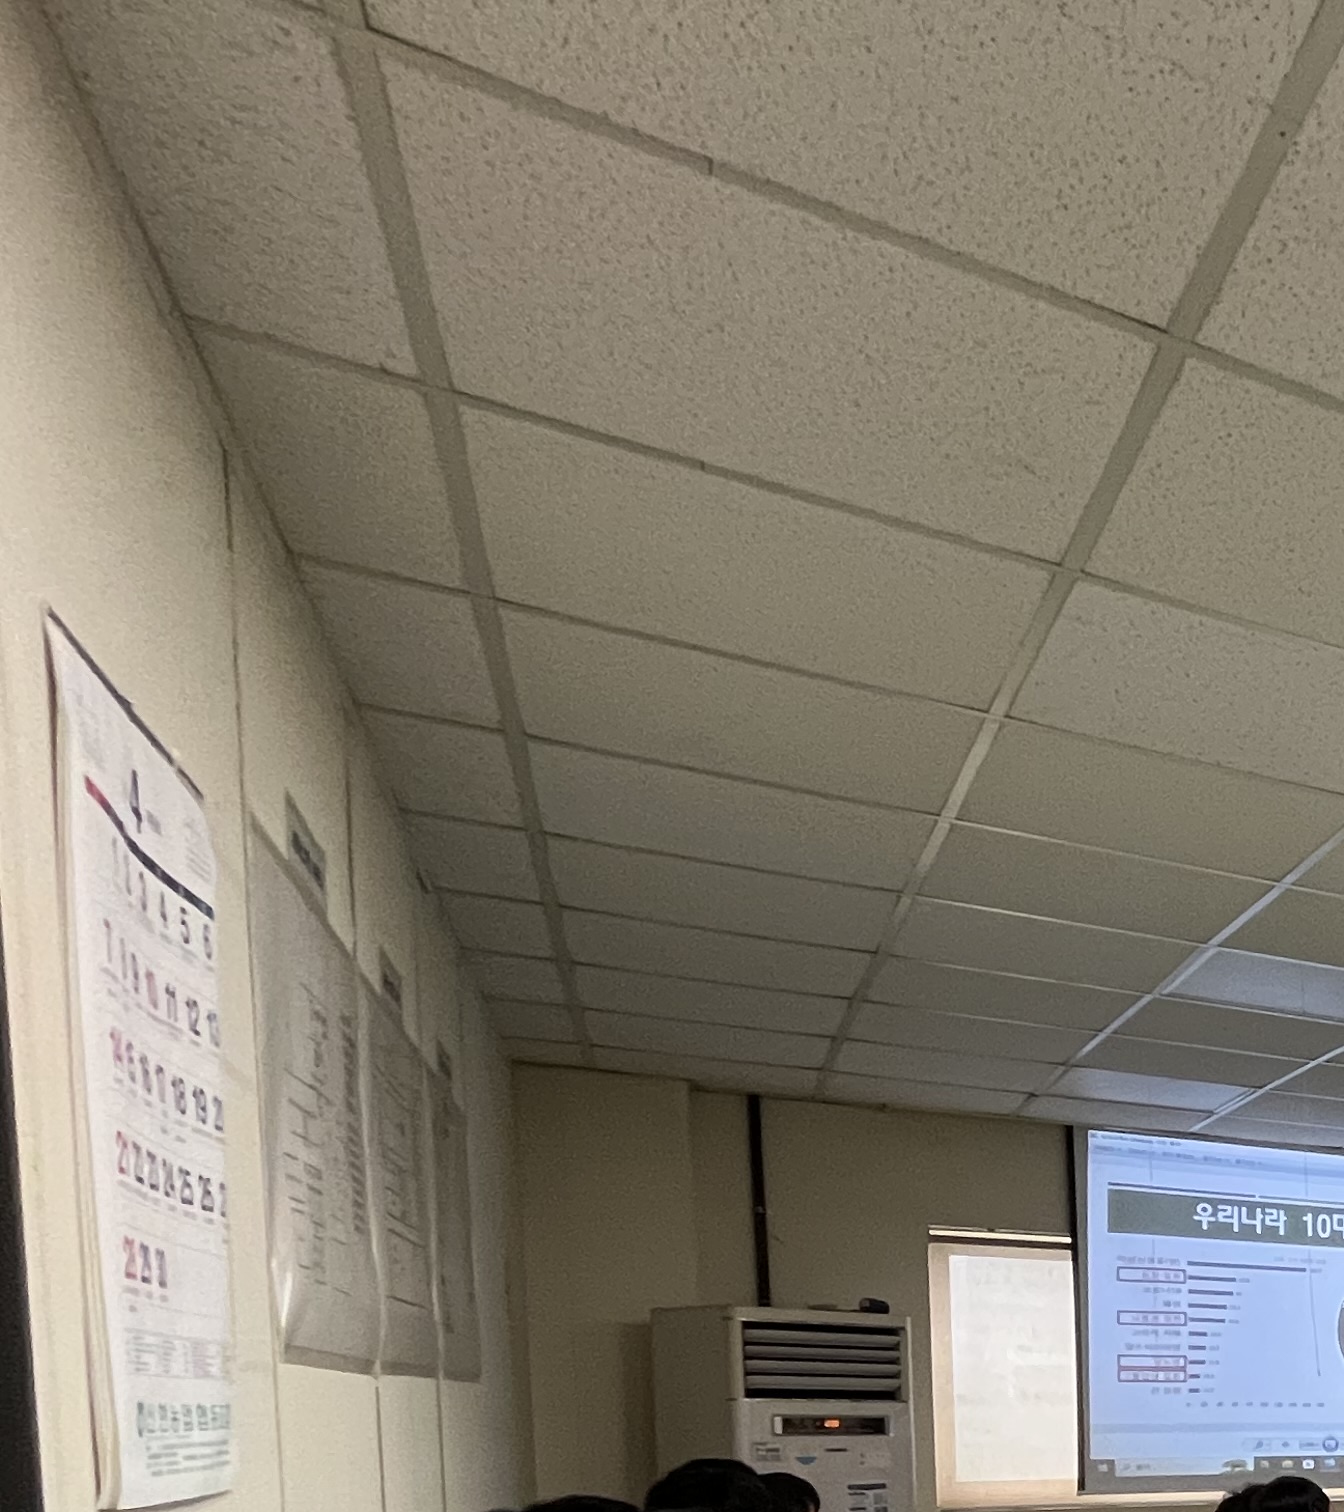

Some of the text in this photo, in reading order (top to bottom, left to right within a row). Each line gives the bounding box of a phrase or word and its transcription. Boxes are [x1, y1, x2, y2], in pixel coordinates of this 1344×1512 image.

[129, 768, 143, 834] 4
[158, 891, 169, 929] 4
[179, 906, 191, 945] 5
[203, 923, 213, 960] 6
[165, 983, 179, 1023] 11
[185, 997, 202, 1037] 12
[171, 1077, 188, 1116] 18
[192, 1086, 208, 1126] 19
[178, 1165, 195, 1206] 25
[199, 1174, 215, 1213] 26
[1192, 1202, 1288, 1236] 우리나라
